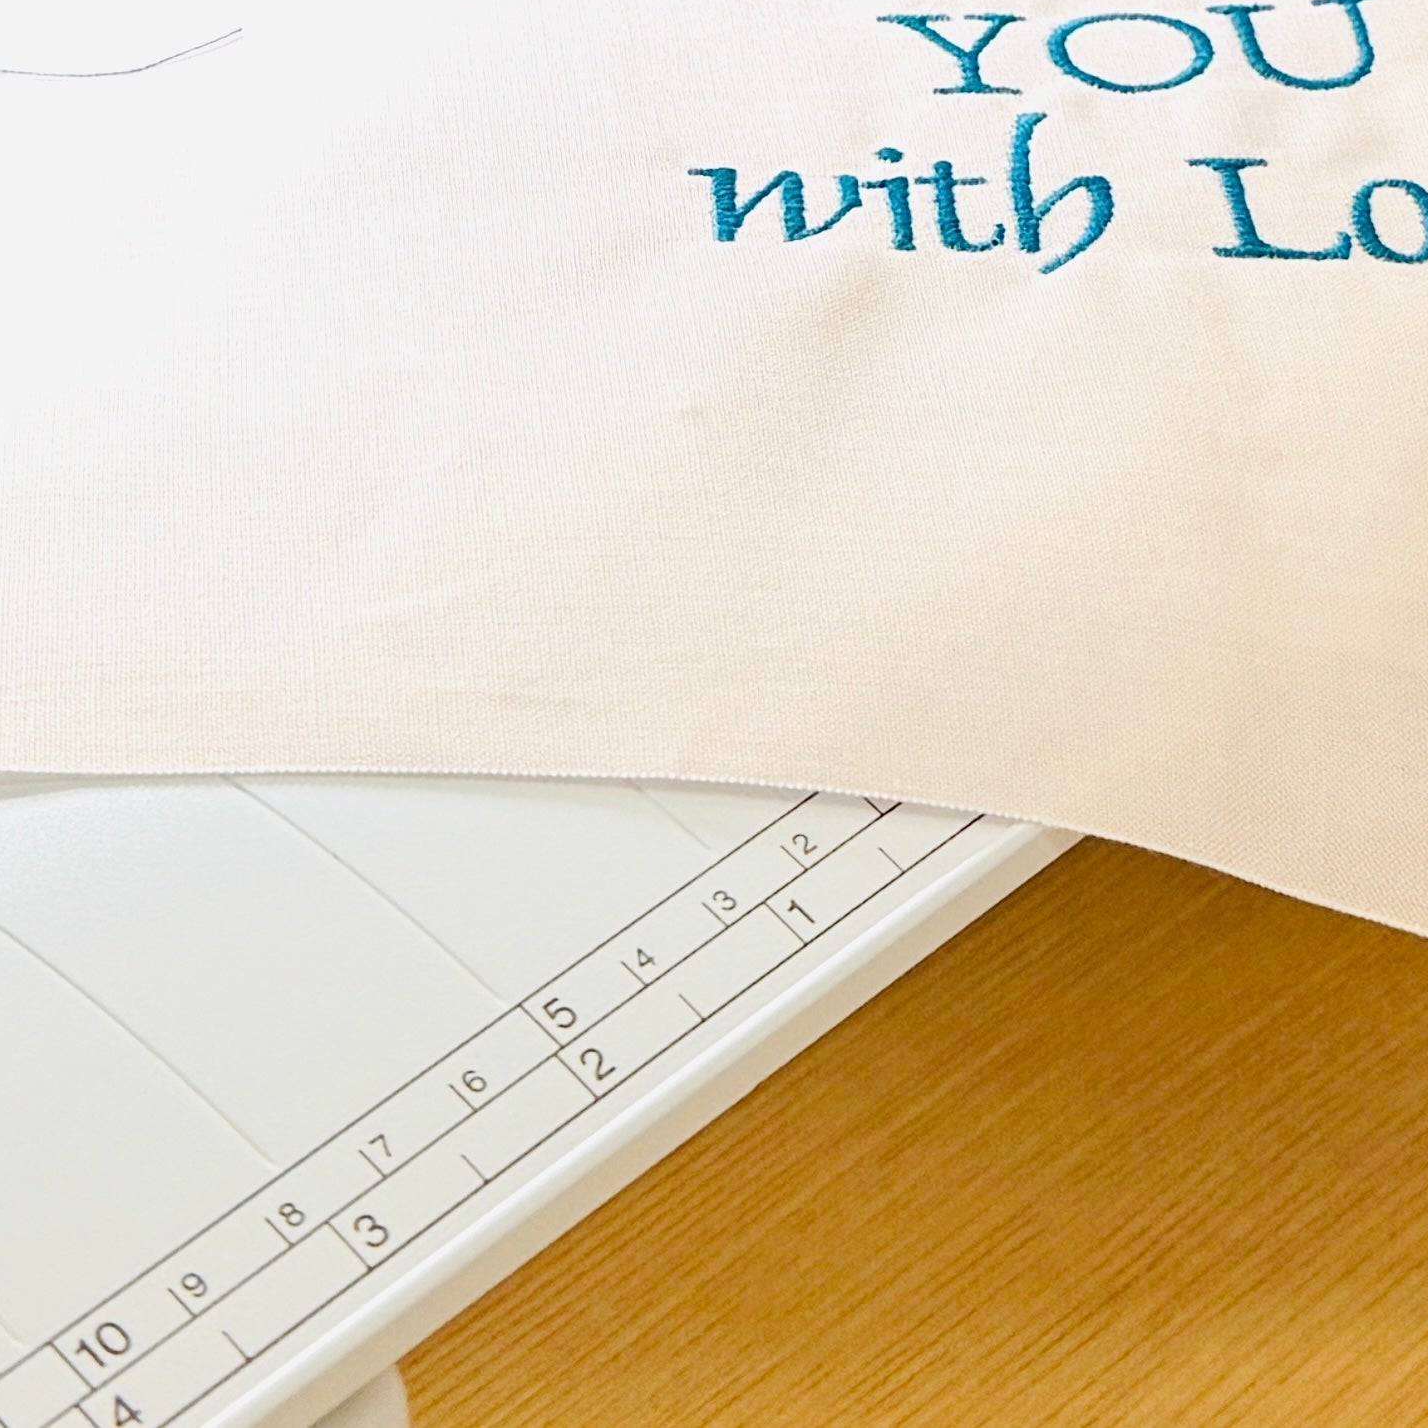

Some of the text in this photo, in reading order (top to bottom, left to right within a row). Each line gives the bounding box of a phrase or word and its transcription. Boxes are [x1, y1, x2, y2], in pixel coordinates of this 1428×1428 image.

[687, 110, 1117, 276] with
[75, 1321, 132, 1368] 10
[180, 1271, 209, 1299] 9
[277, 1201, 307, 1228] 8
[367, 1133, 392, 1158] 7
[461, 1069, 488, 1094] 6
[541, 996, 579, 1030] 5
[635, 946, 657, 969] 4
[711, 889, 738, 912] 3
[791, 832, 819, 856] 2
[113, 899, 817, 1428] 4 3 2 1
